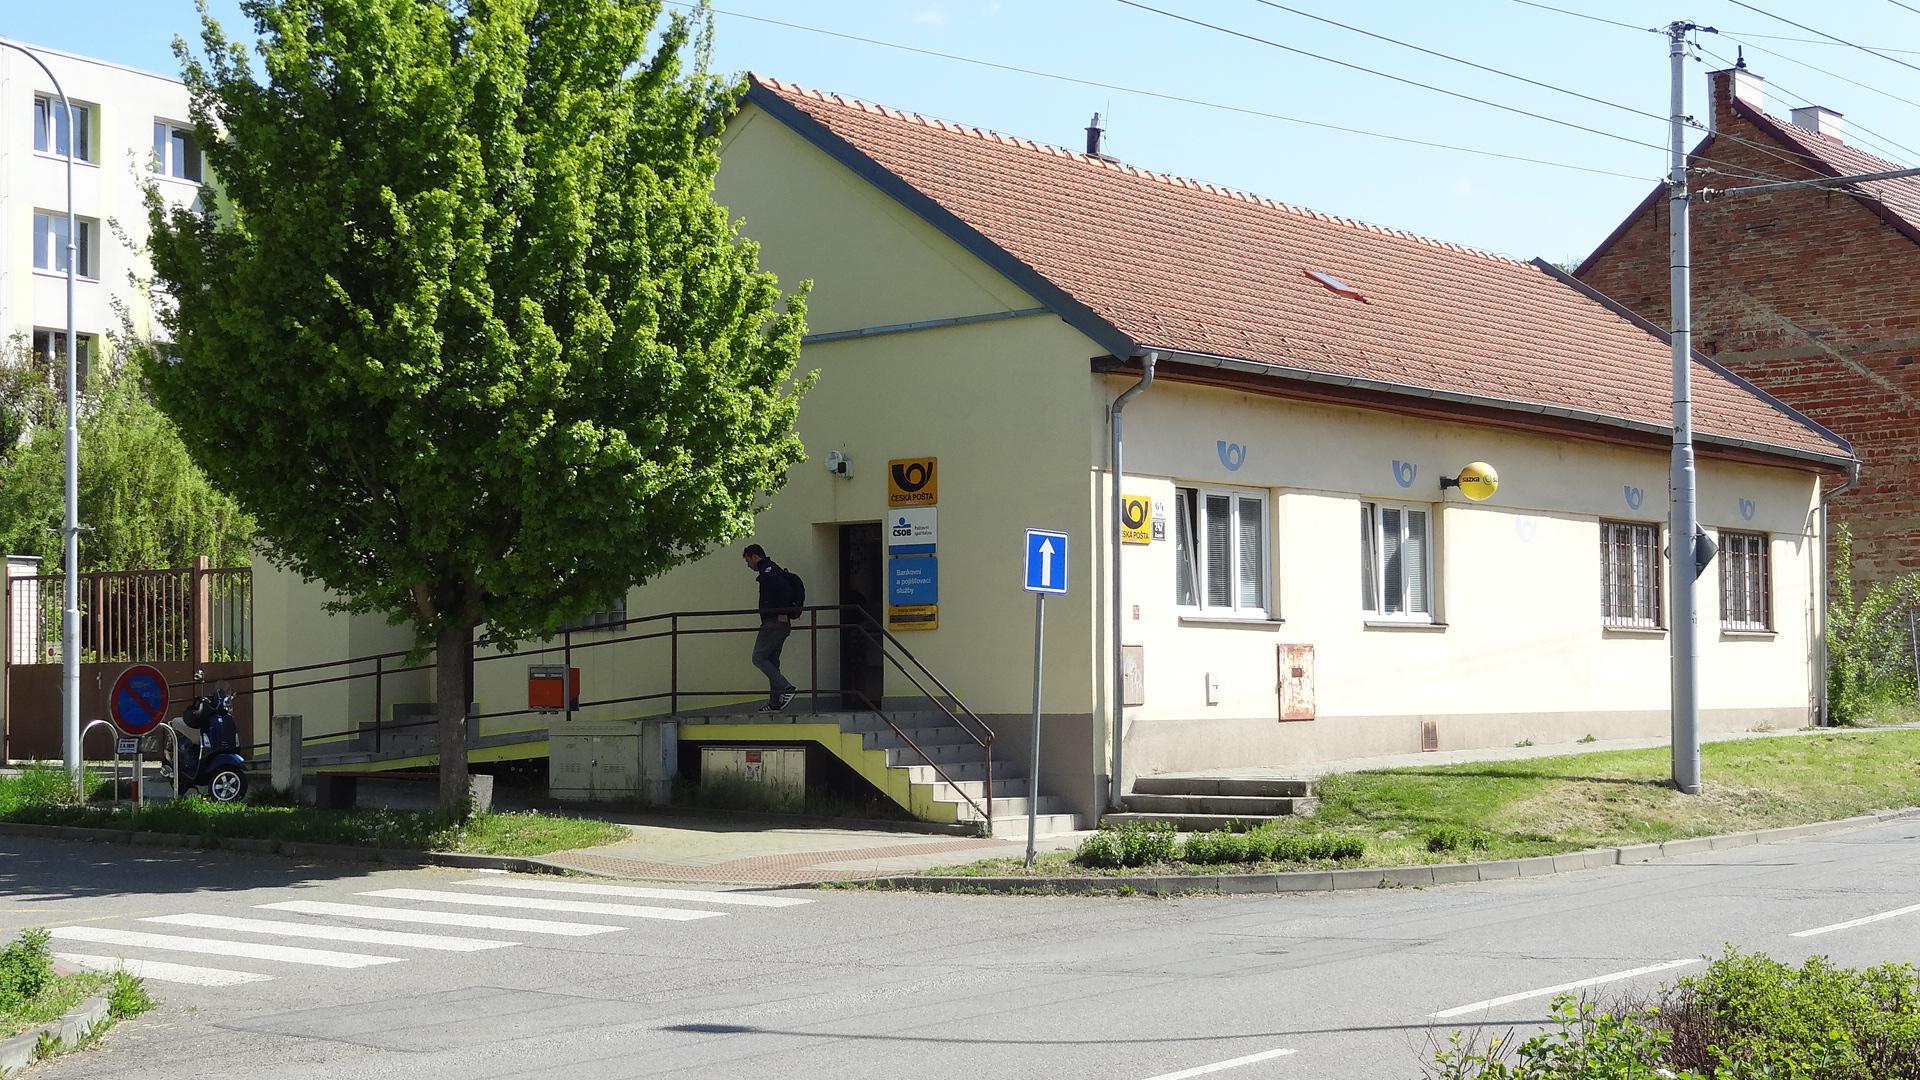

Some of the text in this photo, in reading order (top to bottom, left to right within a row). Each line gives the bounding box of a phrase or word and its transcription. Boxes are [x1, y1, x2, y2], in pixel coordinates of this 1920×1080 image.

[891, 492, 934, 502] ČESKÁ POŠTA
[1122, 530, 1133, 538] SKÁ
[1133, 531, 1148, 539] POŠTA
[896, 568, 922, 576] Bankovní
[896, 587, 914, 595] služby
